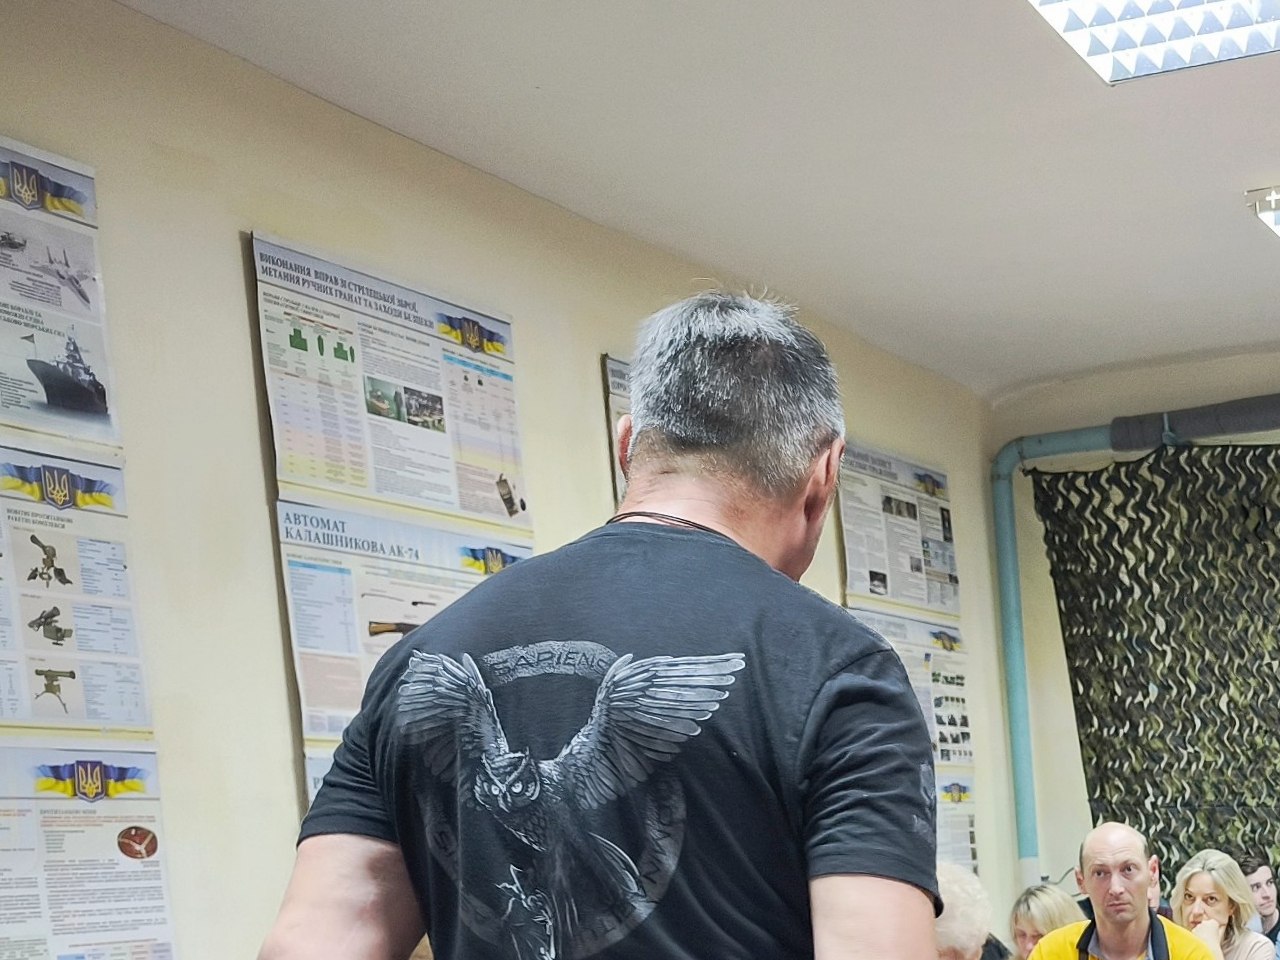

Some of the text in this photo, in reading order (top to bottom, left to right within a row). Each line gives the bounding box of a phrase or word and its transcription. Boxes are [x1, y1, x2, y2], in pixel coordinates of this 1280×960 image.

[259, 252, 311, 276] ВИКОНАННЯ
[314, 269, 340, 287] ВПРАВ
[261, 265, 301, 285] МЕТАННЯ
[301, 278, 335, 297] РУЧНИХ
[335, 288, 362, 305] ГРАНАТ
[364, 297, 374, 309] ТА
[283, 511, 347, 533] АВТОМАТ
[285, 526, 420, 561] КАЛАШНИКОВА АК-74
